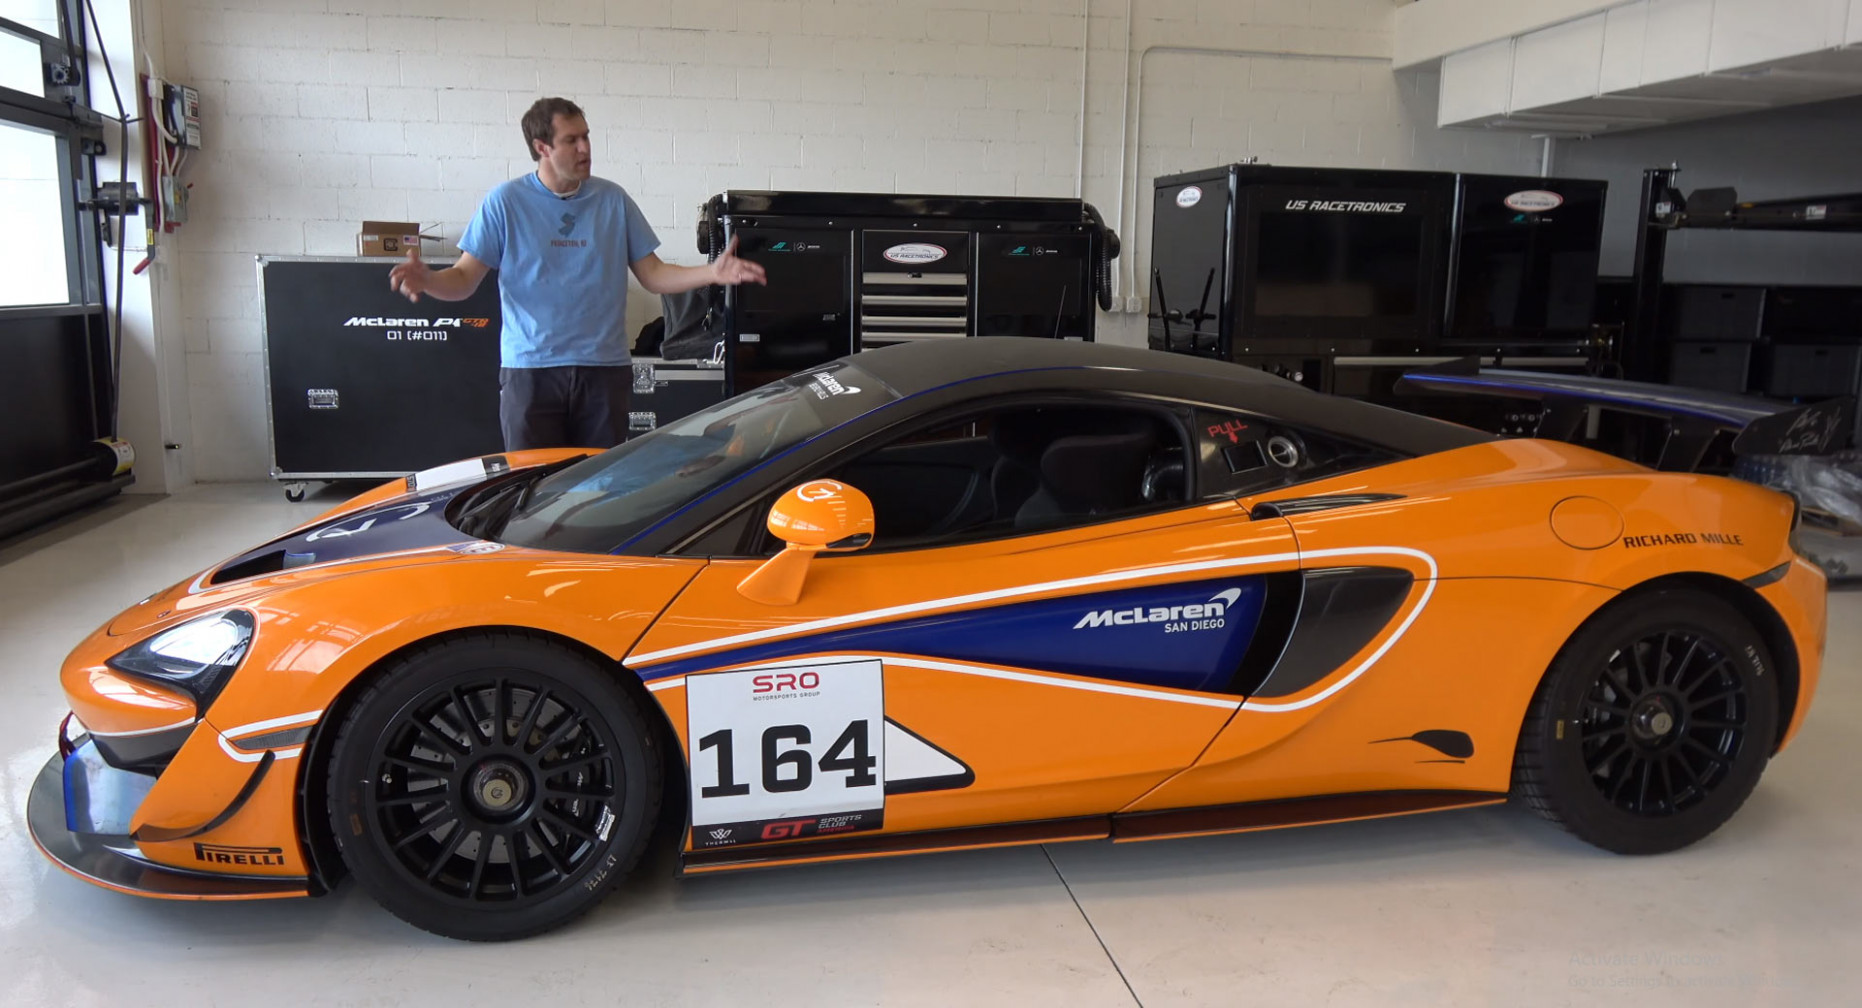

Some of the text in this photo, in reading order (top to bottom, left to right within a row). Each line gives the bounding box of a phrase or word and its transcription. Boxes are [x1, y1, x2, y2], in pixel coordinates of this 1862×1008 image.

[1285, 200, 1406, 213] US RACETRONICS
[344, 317, 430, 328] McLaren
[387, 331, 403, 341] 01
[1207, 420, 1247, 437] PULL
[1623, 533, 1743, 549] RICHARD MILLE
[1073, 603, 1225, 629] McLaren
[1164, 617, 1225, 633] SAN DIEGO
[753, 672, 819, 692] SRO
[753, 690, 821, 701] MOTORSPORTS GROUP
[699, 719, 876, 799] 164
[818, 821, 847, 829] CLUB
[820, 814, 862, 824] SPORTS
[761, 819, 818, 840] GT
[194, 842, 286, 866] PIRELLI
